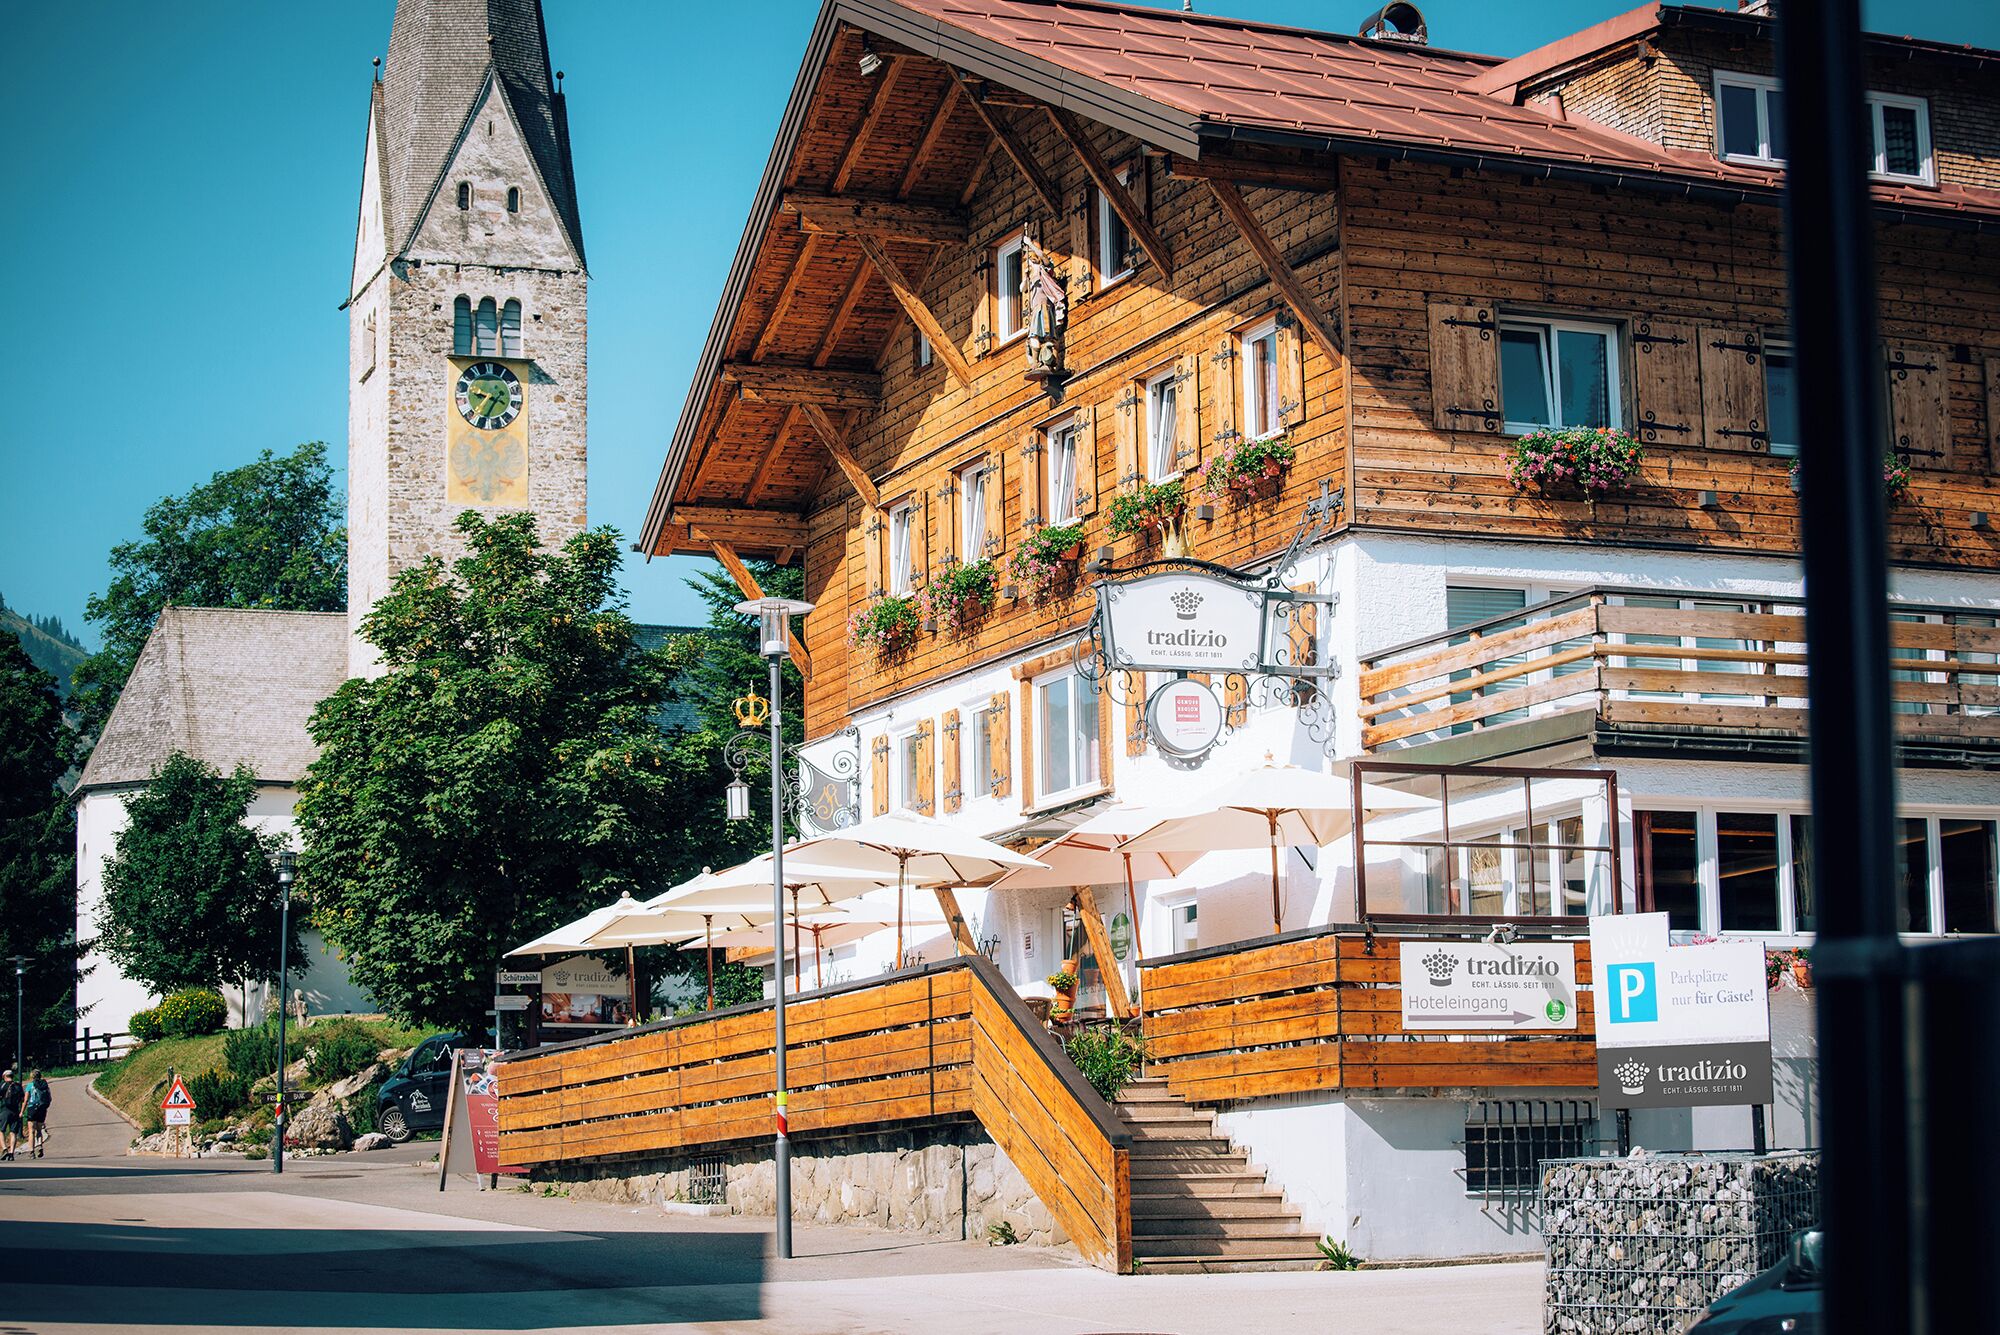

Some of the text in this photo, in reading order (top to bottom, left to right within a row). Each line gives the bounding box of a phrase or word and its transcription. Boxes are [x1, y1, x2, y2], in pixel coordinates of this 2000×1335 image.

[1147, 629, 1227, 648] tradizio
[1151, 649, 1168, 657] ECHT.
[1467, 955, 1560, 977] tradizio
[503, 973, 539, 982] Schützabühl
[574, 971, 618, 983] tradizio
[1472, 980, 1555, 990] ECHT. LÄSSIG. SEIT 1811
[1670, 968, 1728, 987] Parkplätze
[1619, 968, 1645, 1018] P
[1672, 989, 1754, 1006] nur für Gäste!
[1408, 995, 1508, 1012] Hoteleingang
[1657, 1059, 1747, 1082] tradizio
[1663, 1084, 1743, 1095] ECHT. LÄSSIG. SEIT 1811
